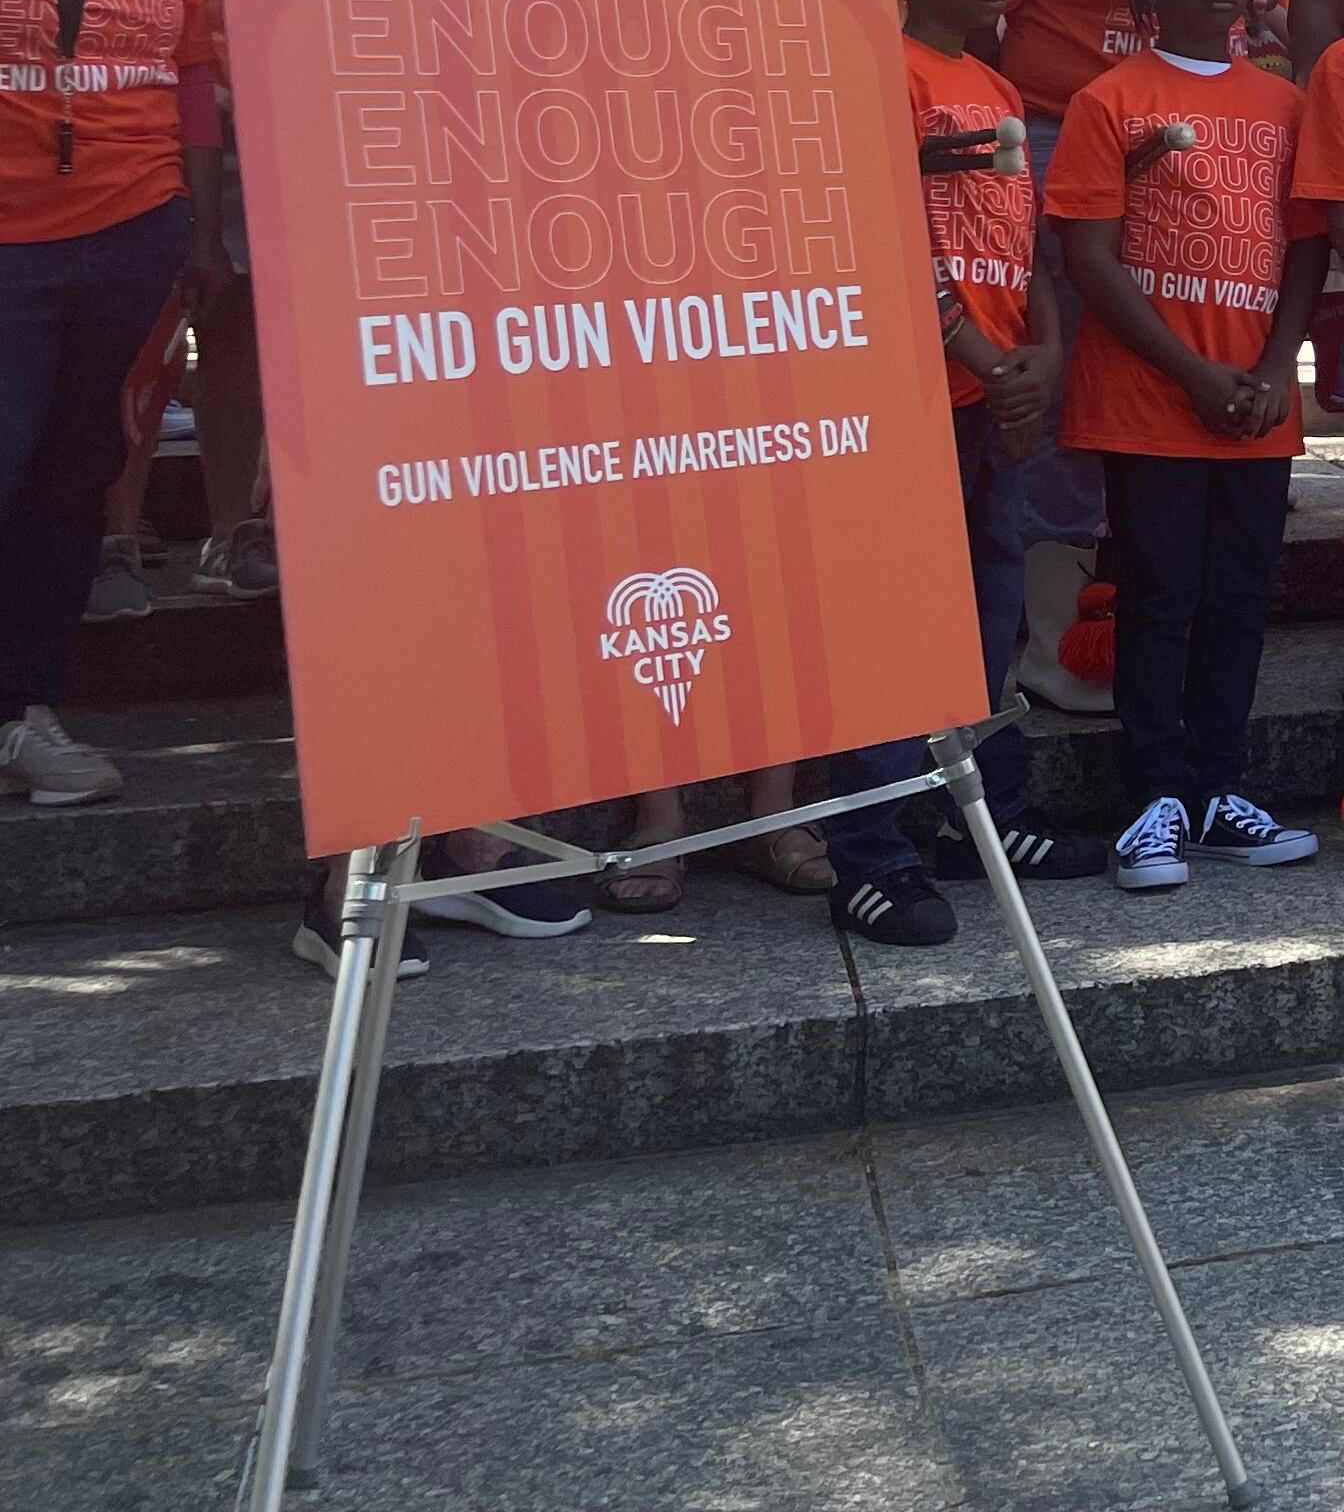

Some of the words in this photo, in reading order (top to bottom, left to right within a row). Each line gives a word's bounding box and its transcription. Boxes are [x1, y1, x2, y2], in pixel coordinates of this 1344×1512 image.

[0, 63, 47, 92] END
[54, 63, 108, 93] GUN
[335, 88, 844, 187] ENOUGH
[346, 187, 857, 300] ENOUGH
[1124, 265, 1156, 295] ND
[1161, 271, 1208, 304] GUN
[358, 310, 476, 386] END
[496, 301, 611, 374] GUN
[624, 285, 870, 364] VIOLENCE
[378, 458, 453, 508] GUN
[461, 441, 623, 497] VIOLENCE
[632, 420, 812, 479] AWARENESS
[819, 415, 871, 456] DAY
[600, 614, 732, 660] KANSAS
[633, 648, 705, 685] CITY
